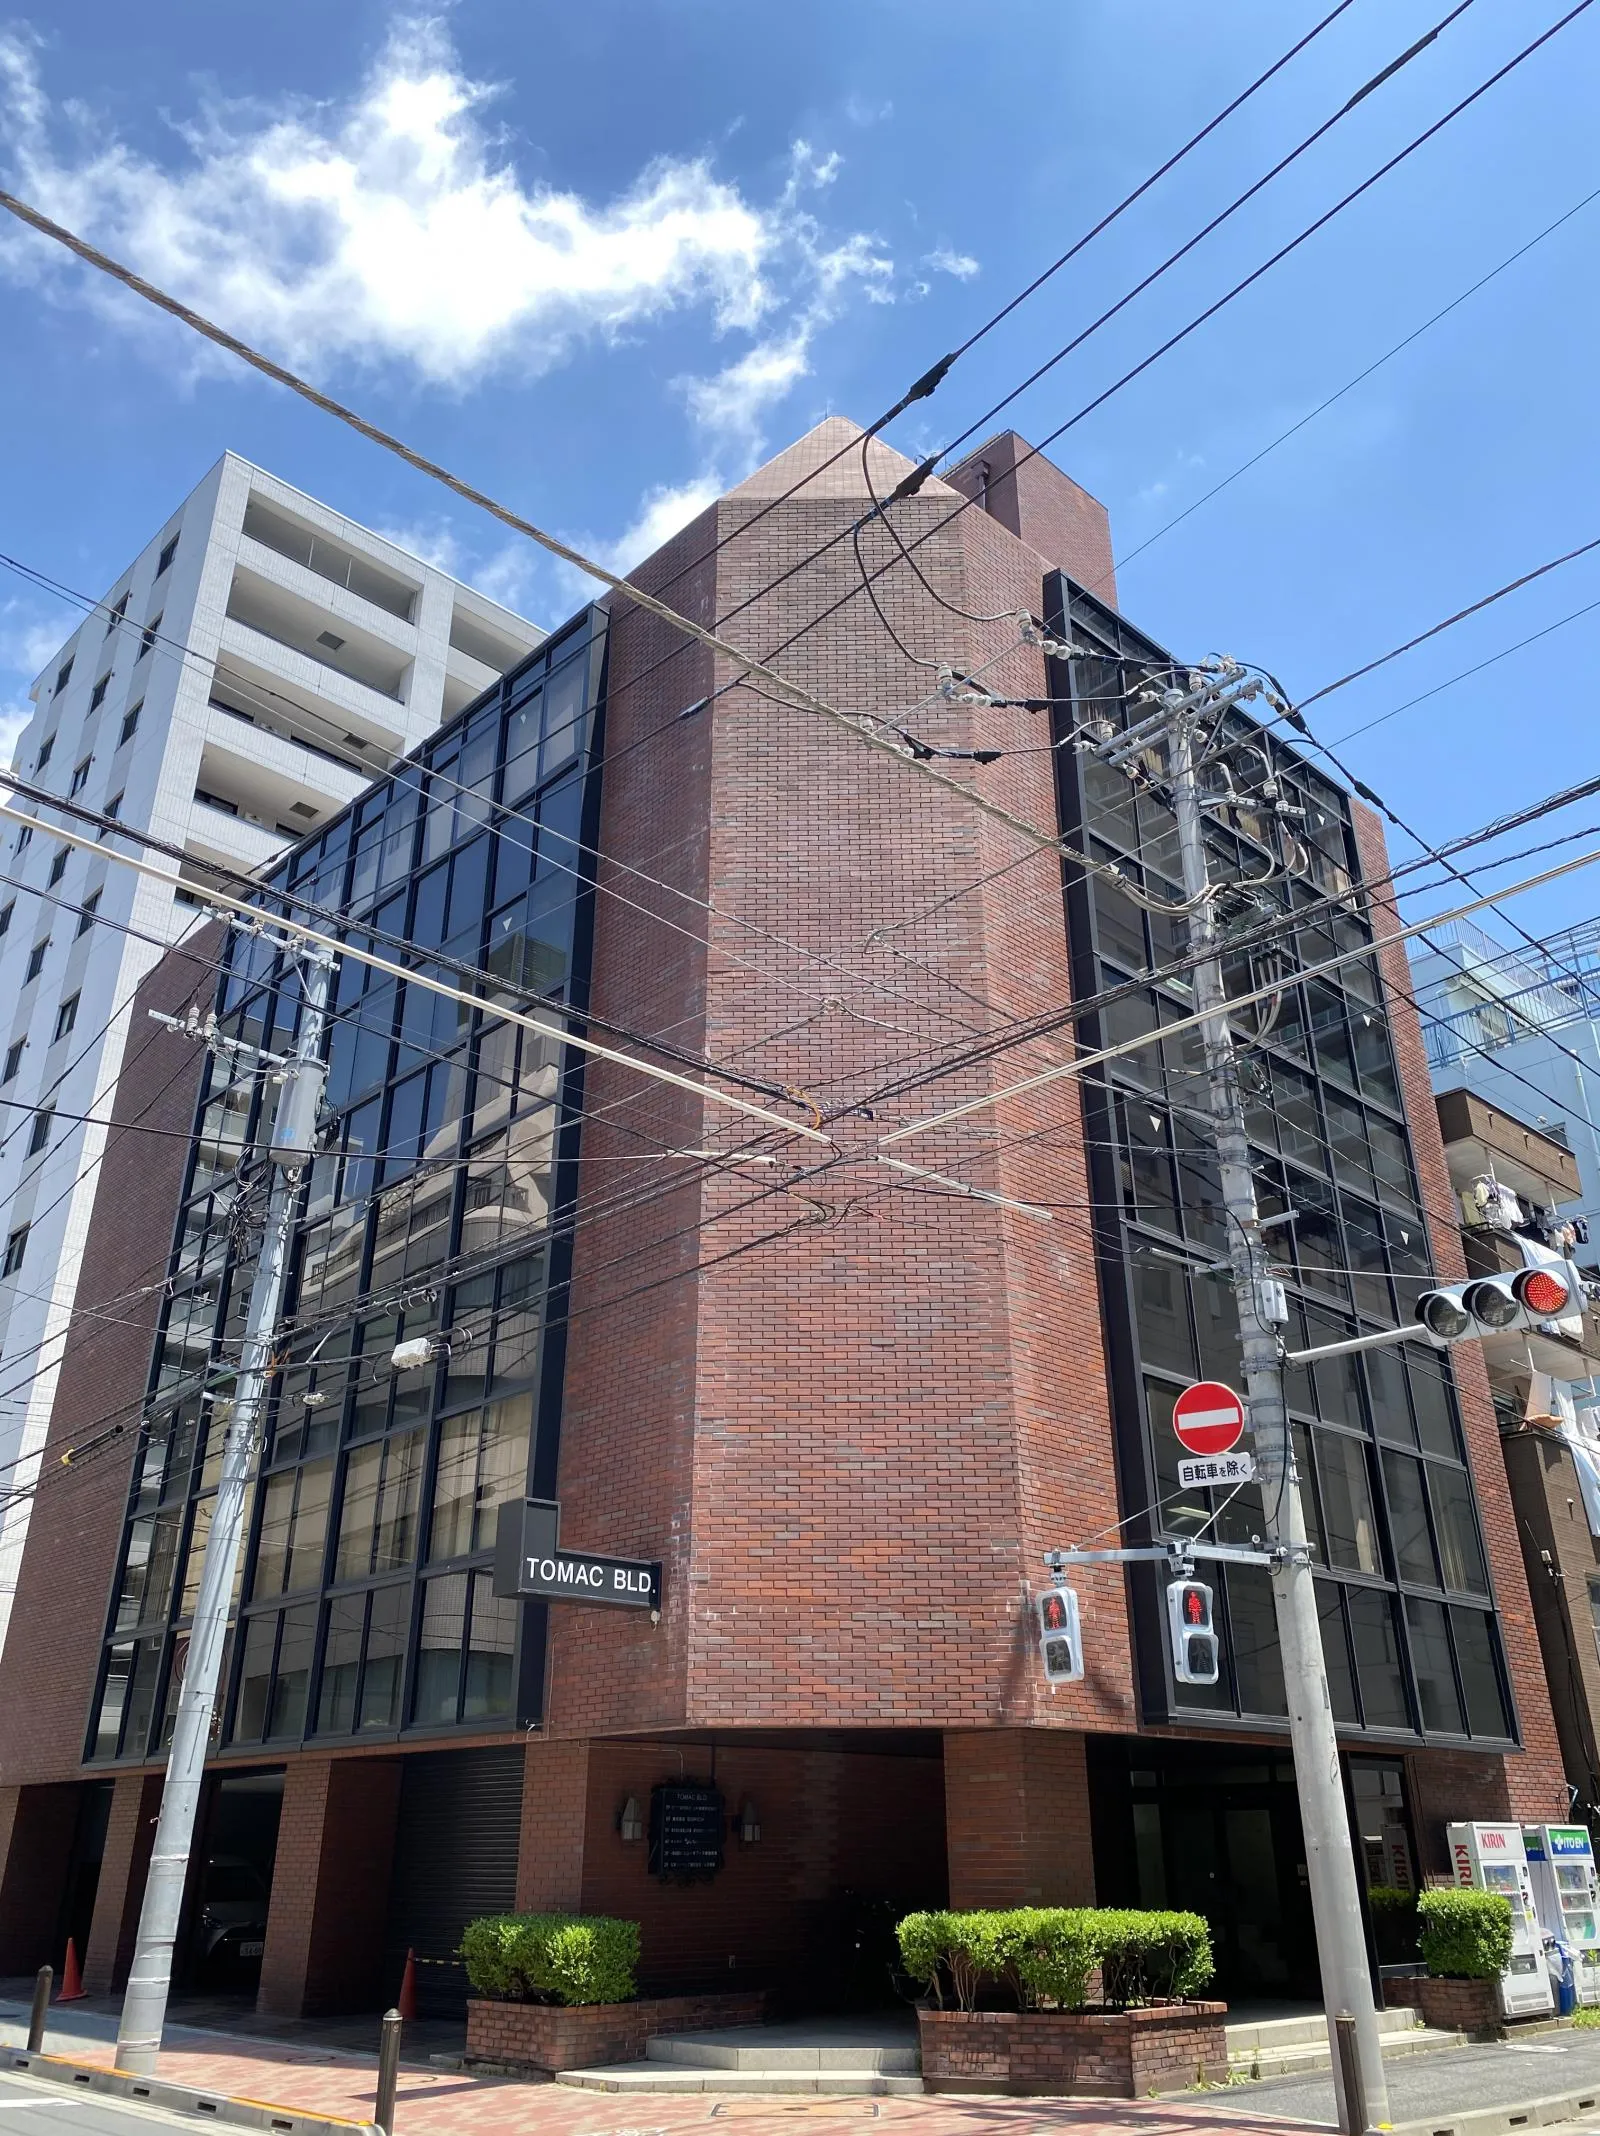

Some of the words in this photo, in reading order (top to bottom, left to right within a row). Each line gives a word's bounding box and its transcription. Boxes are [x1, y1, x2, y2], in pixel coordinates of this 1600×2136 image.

[1183, 1460, 1247, 1481] 自転車を除く
[526, 1557, 604, 1587] TOMAC
[613, 1569, 656, 1594] BLD.
[1480, 1833, 1506, 1848] KIRIN
[1563, 1837, 1575, 1849] ITO
[1575, 1837, 1584, 1849] EN
[1454, 1844, 1474, 1889] KIRI
